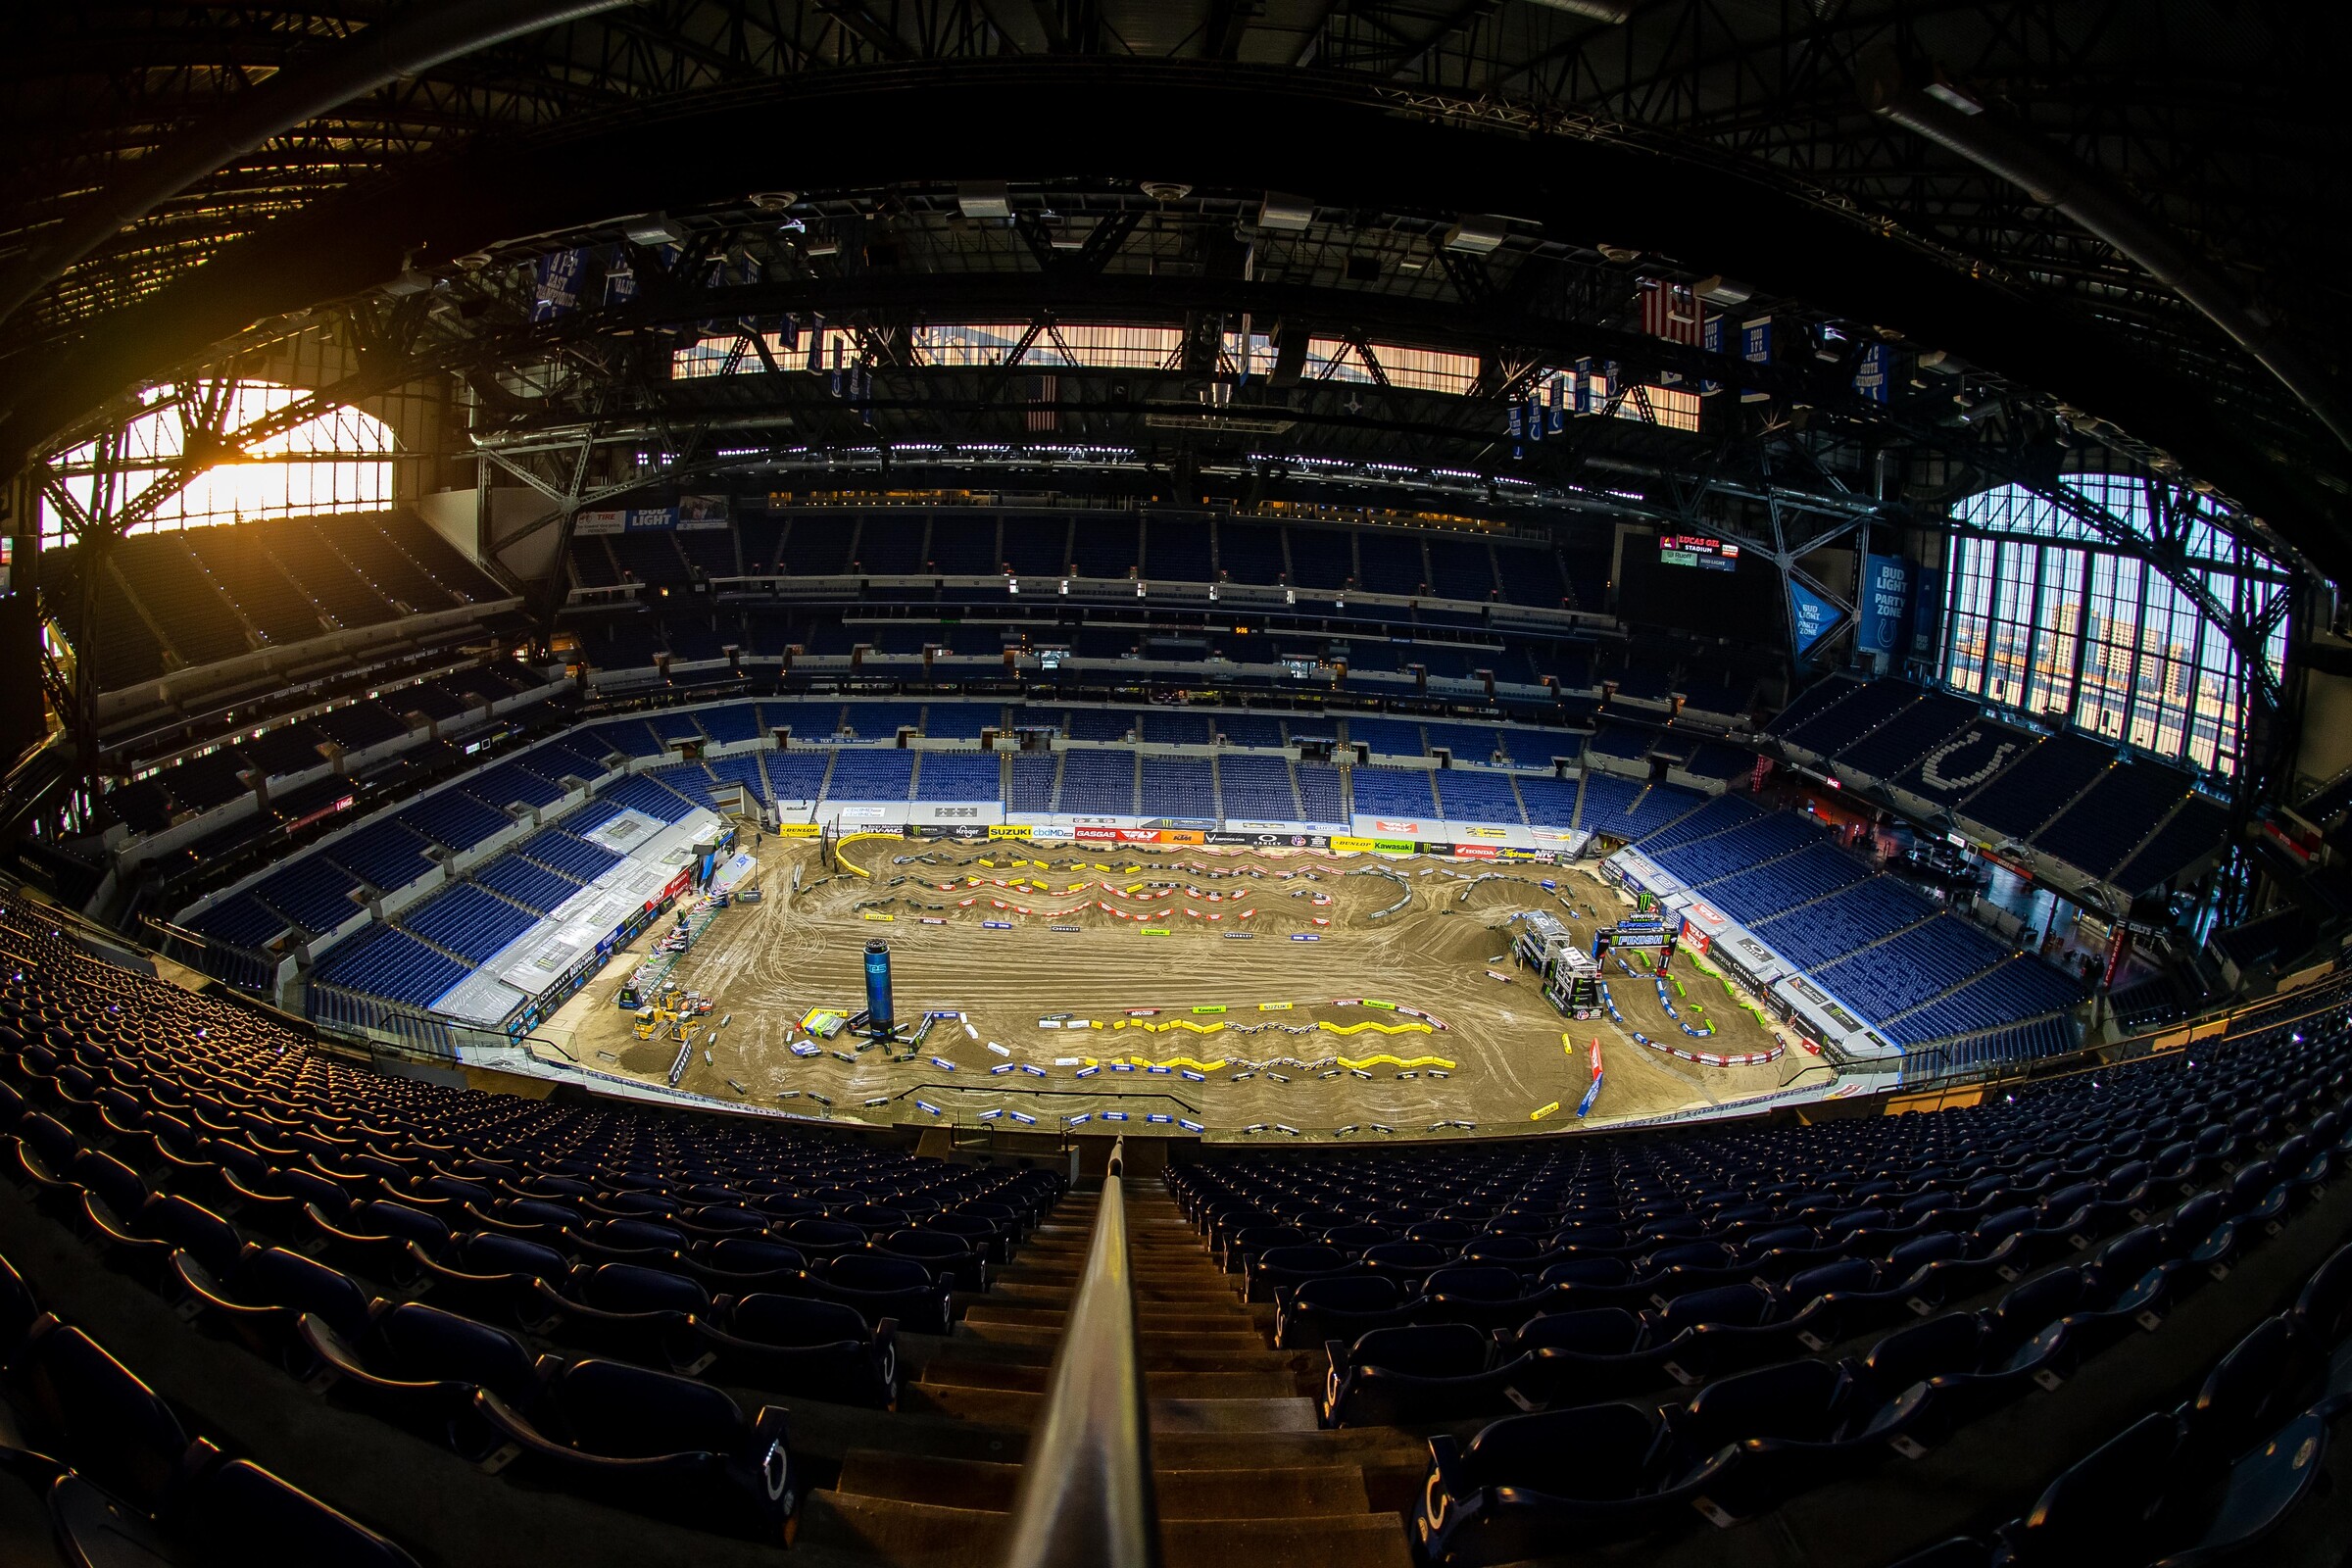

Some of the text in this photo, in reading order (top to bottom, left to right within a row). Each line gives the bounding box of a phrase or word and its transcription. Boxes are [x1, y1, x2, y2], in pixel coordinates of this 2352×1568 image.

[632, 514, 671, 526] LIGHT
[1679, 535, 1720, 548] LUCAS OIL
[1685, 545, 1712, 554] STADIUM
[1882, 565, 1905, 581] BUD
[1877, 576, 1909, 594] LIGHT
[1875, 593, 1906, 608] PARTY
[1802, 604, 1818, 612] BUD
[1877, 605, 1902, 618] ZONE
[1798, 611, 1821, 621] LIGHT
[1797, 621, 1820, 630] PARTY
[956, 825, 979, 838] Kroger
[1374, 842, 1413, 851] Kawasaki
[2129, 922, 2152, 936] COLTS
[1618, 935, 1663, 946] FINISH
[1740, 968, 1759, 986] OAKLEY
[548, 974, 569, 994] OAKLEY
[1738, 978, 1756, 996] OAKLEY
[1537, 1104, 1557, 1117] SUZUKI
